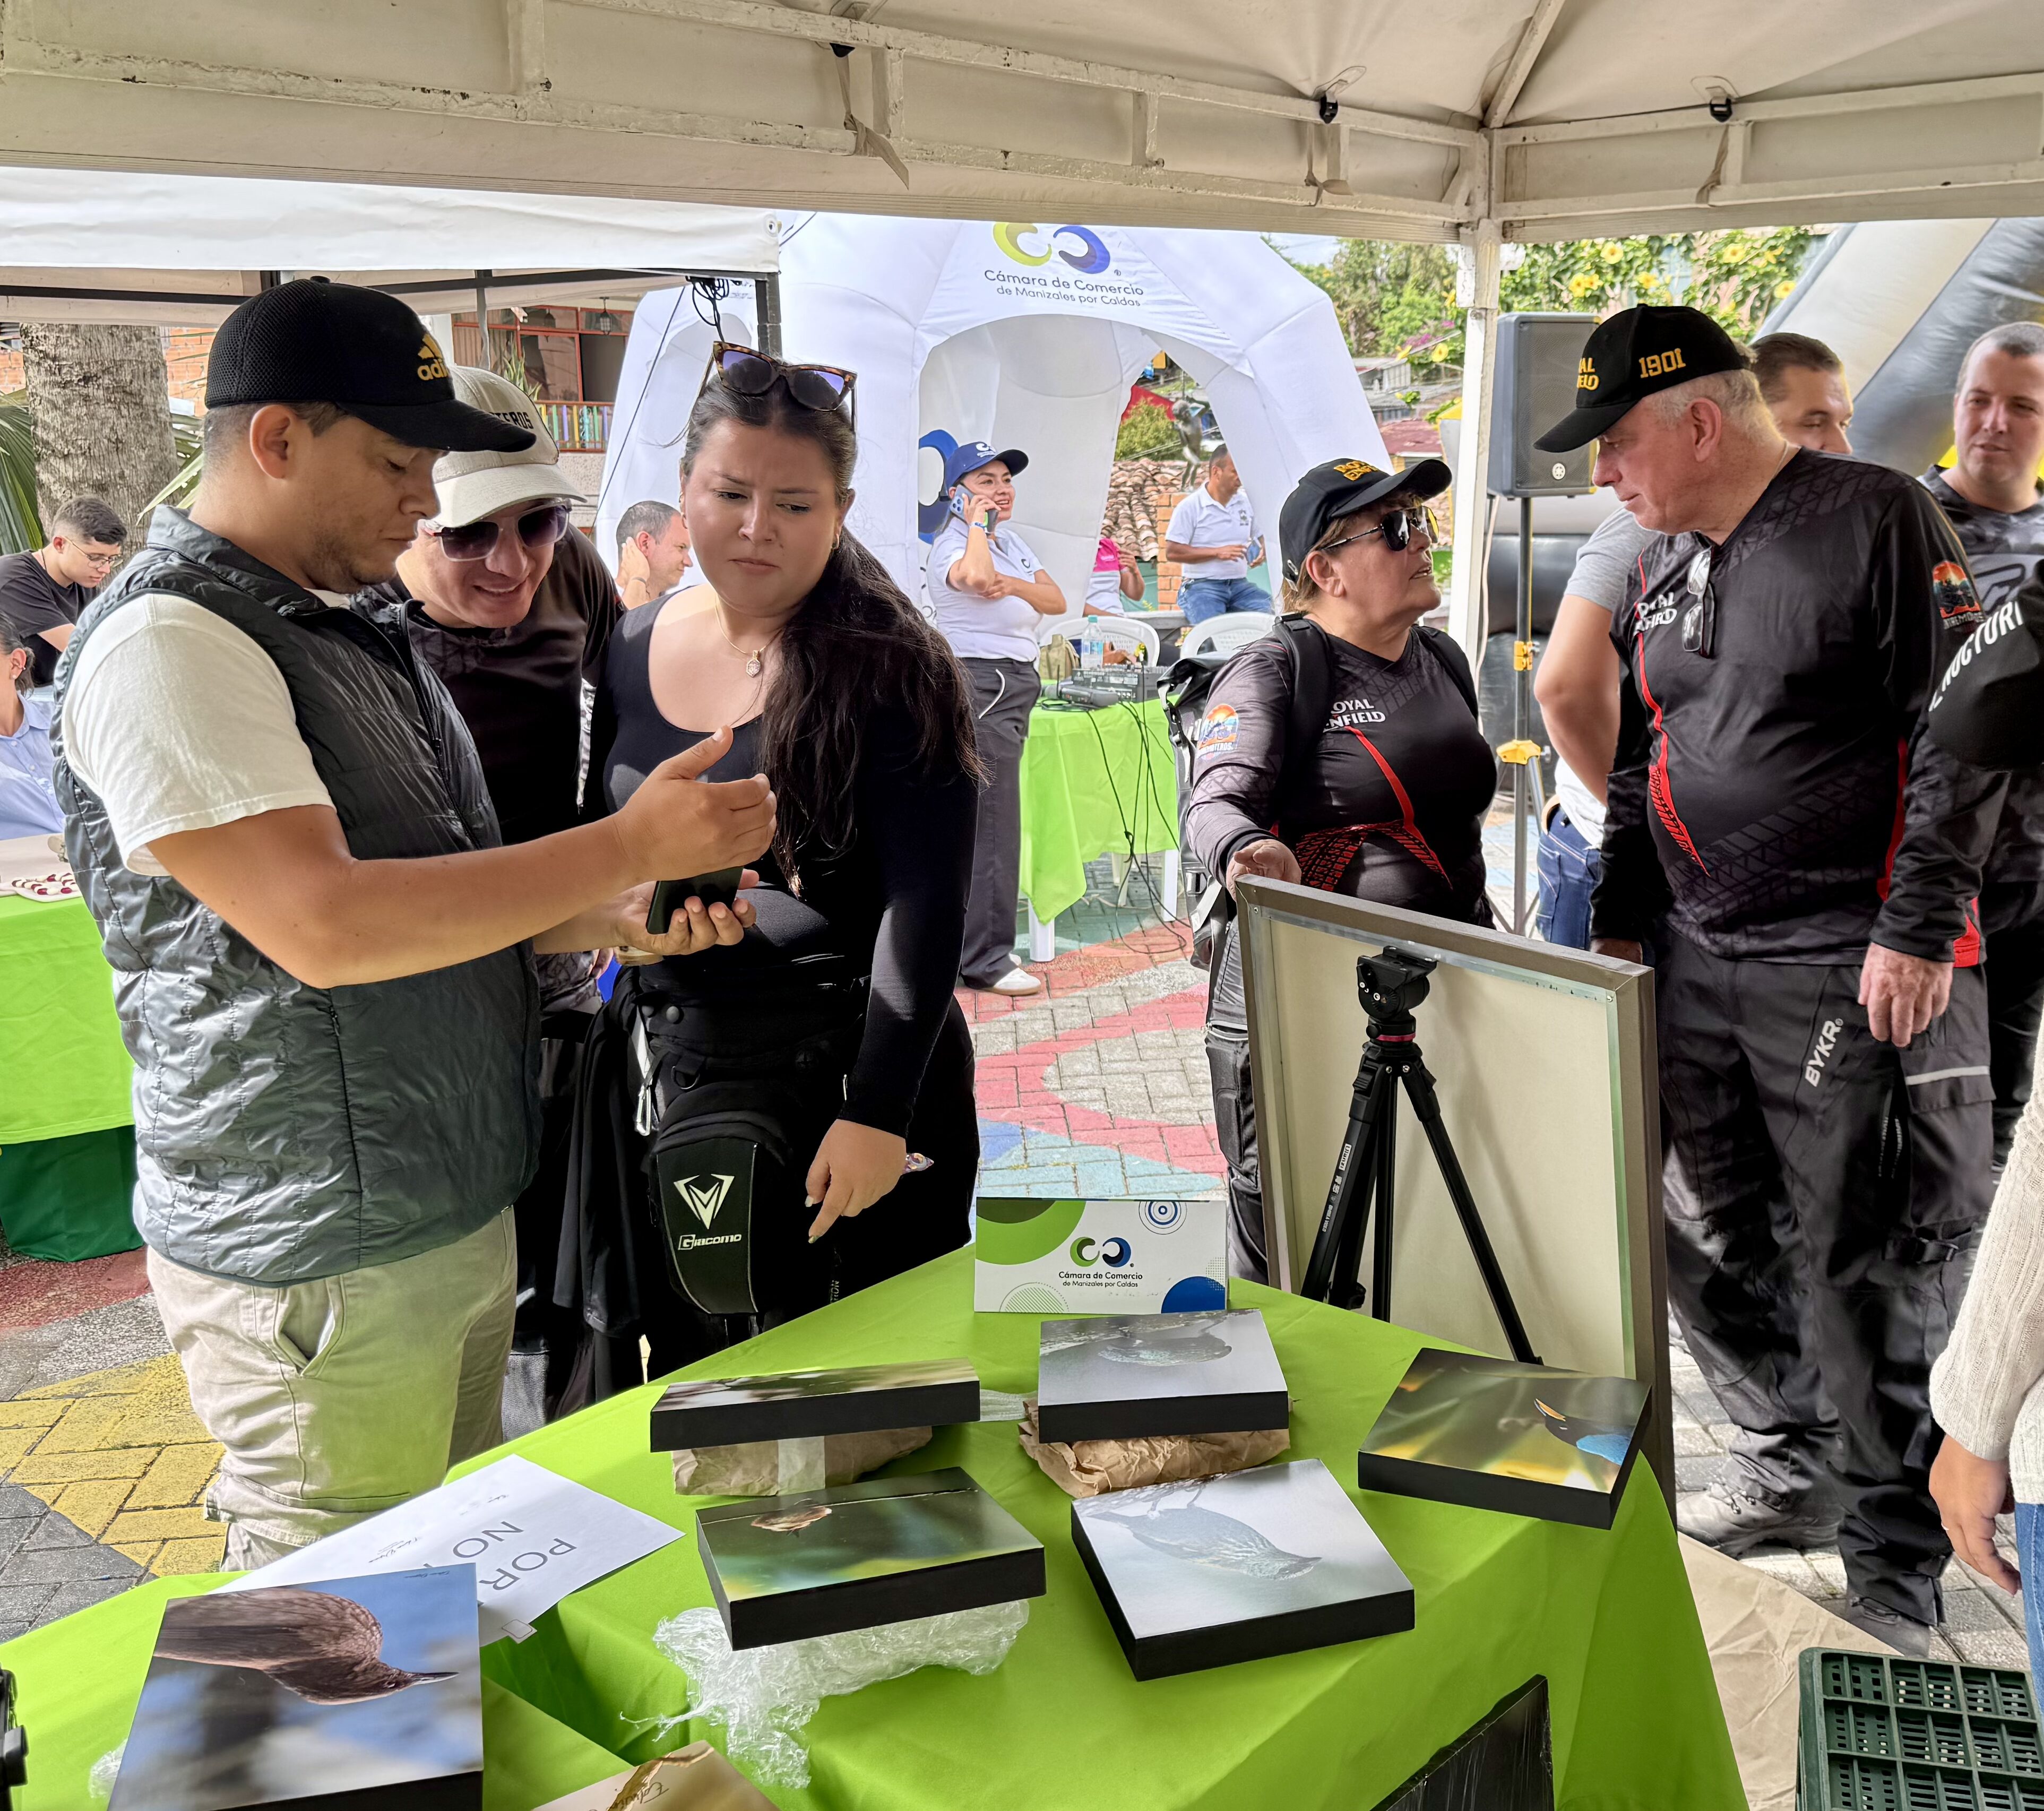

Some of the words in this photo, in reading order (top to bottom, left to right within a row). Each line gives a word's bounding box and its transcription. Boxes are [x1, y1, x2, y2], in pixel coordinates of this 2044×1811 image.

[984, 270, 1047, 287] Cámara
[1052, 277, 1070, 289] de
[1074, 280, 1144, 296] Comercio
[996, 285, 1012, 296] de
[1016, 287, 1075, 302] Manizales
[1079, 295, 1097, 304] por
[1101, 295, 1141, 307] Caldas
[1638, 348, 1686, 378] 1901
[1331, 698, 1375, 714] OYAL
[1323, 711, 1386, 733] NFIELD
[1805, 1020, 1842, 1088] BYKR
[453, 1521, 524, 1558] NO
[479, 1538, 577, 1591] POR
